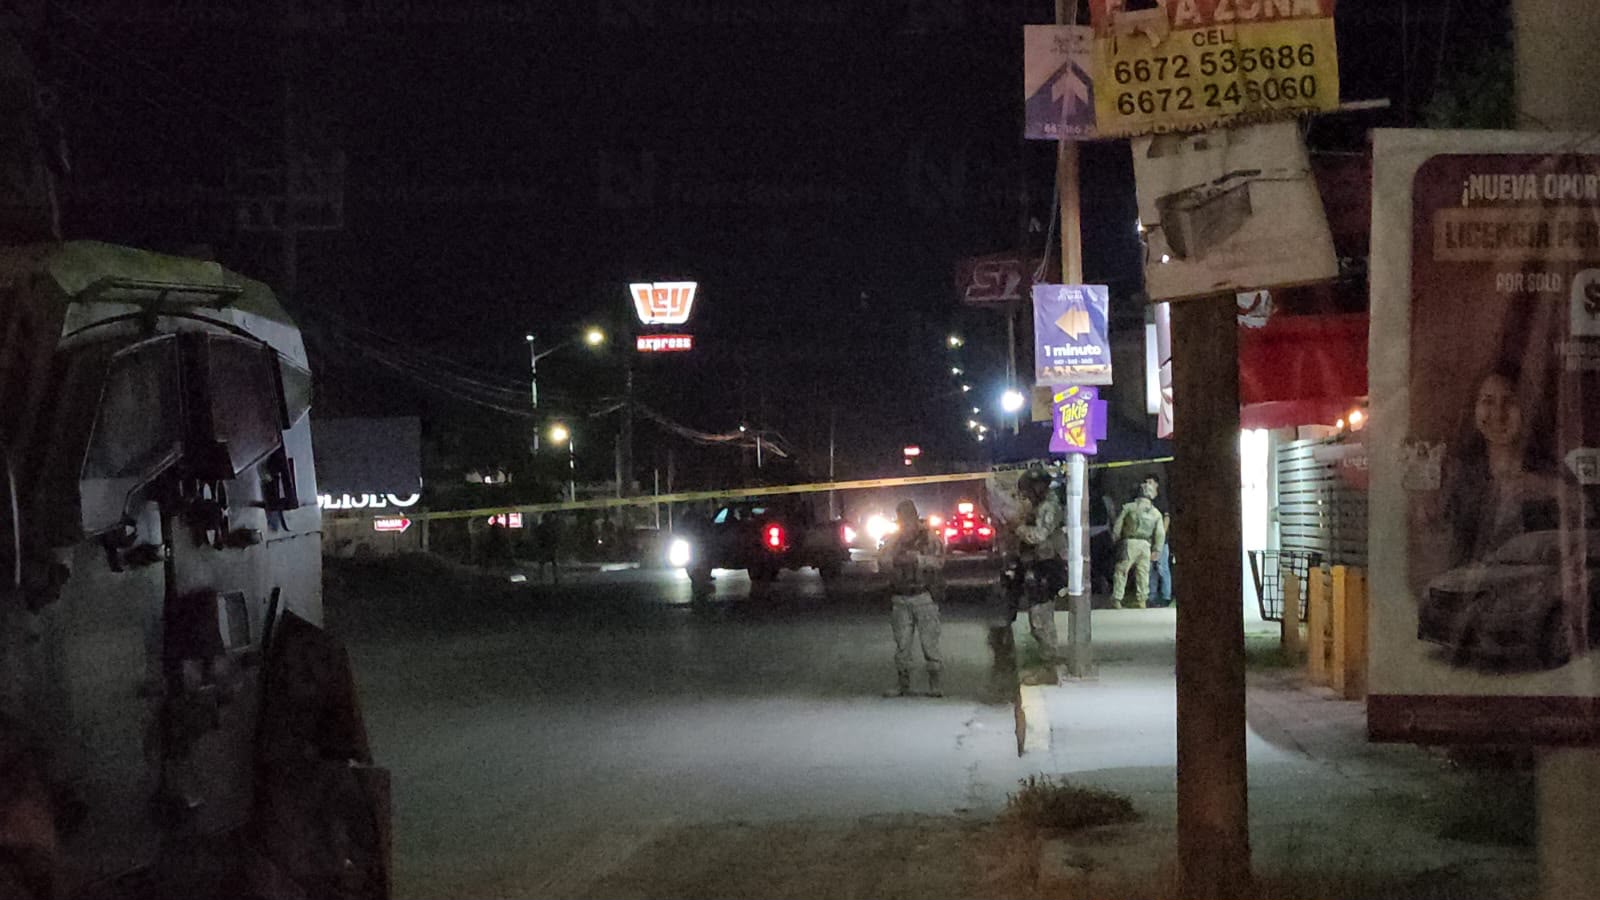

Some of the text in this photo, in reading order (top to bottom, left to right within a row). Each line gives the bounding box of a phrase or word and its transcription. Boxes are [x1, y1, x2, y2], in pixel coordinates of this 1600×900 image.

[1192, 29, 1232, 47] CEL
[1114, 43, 1315, 85] 6672 535686
[1117, 74, 1316, 116] 6672 246060
[1461, 173, 1600, 207] ¡NUEVA OPOR
[1496, 271, 1524, 293] POR
[636, 337, 692, 352] express
[1043, 342, 1102, 357] 1 minuto
[1059, 399, 1089, 427] Takis
